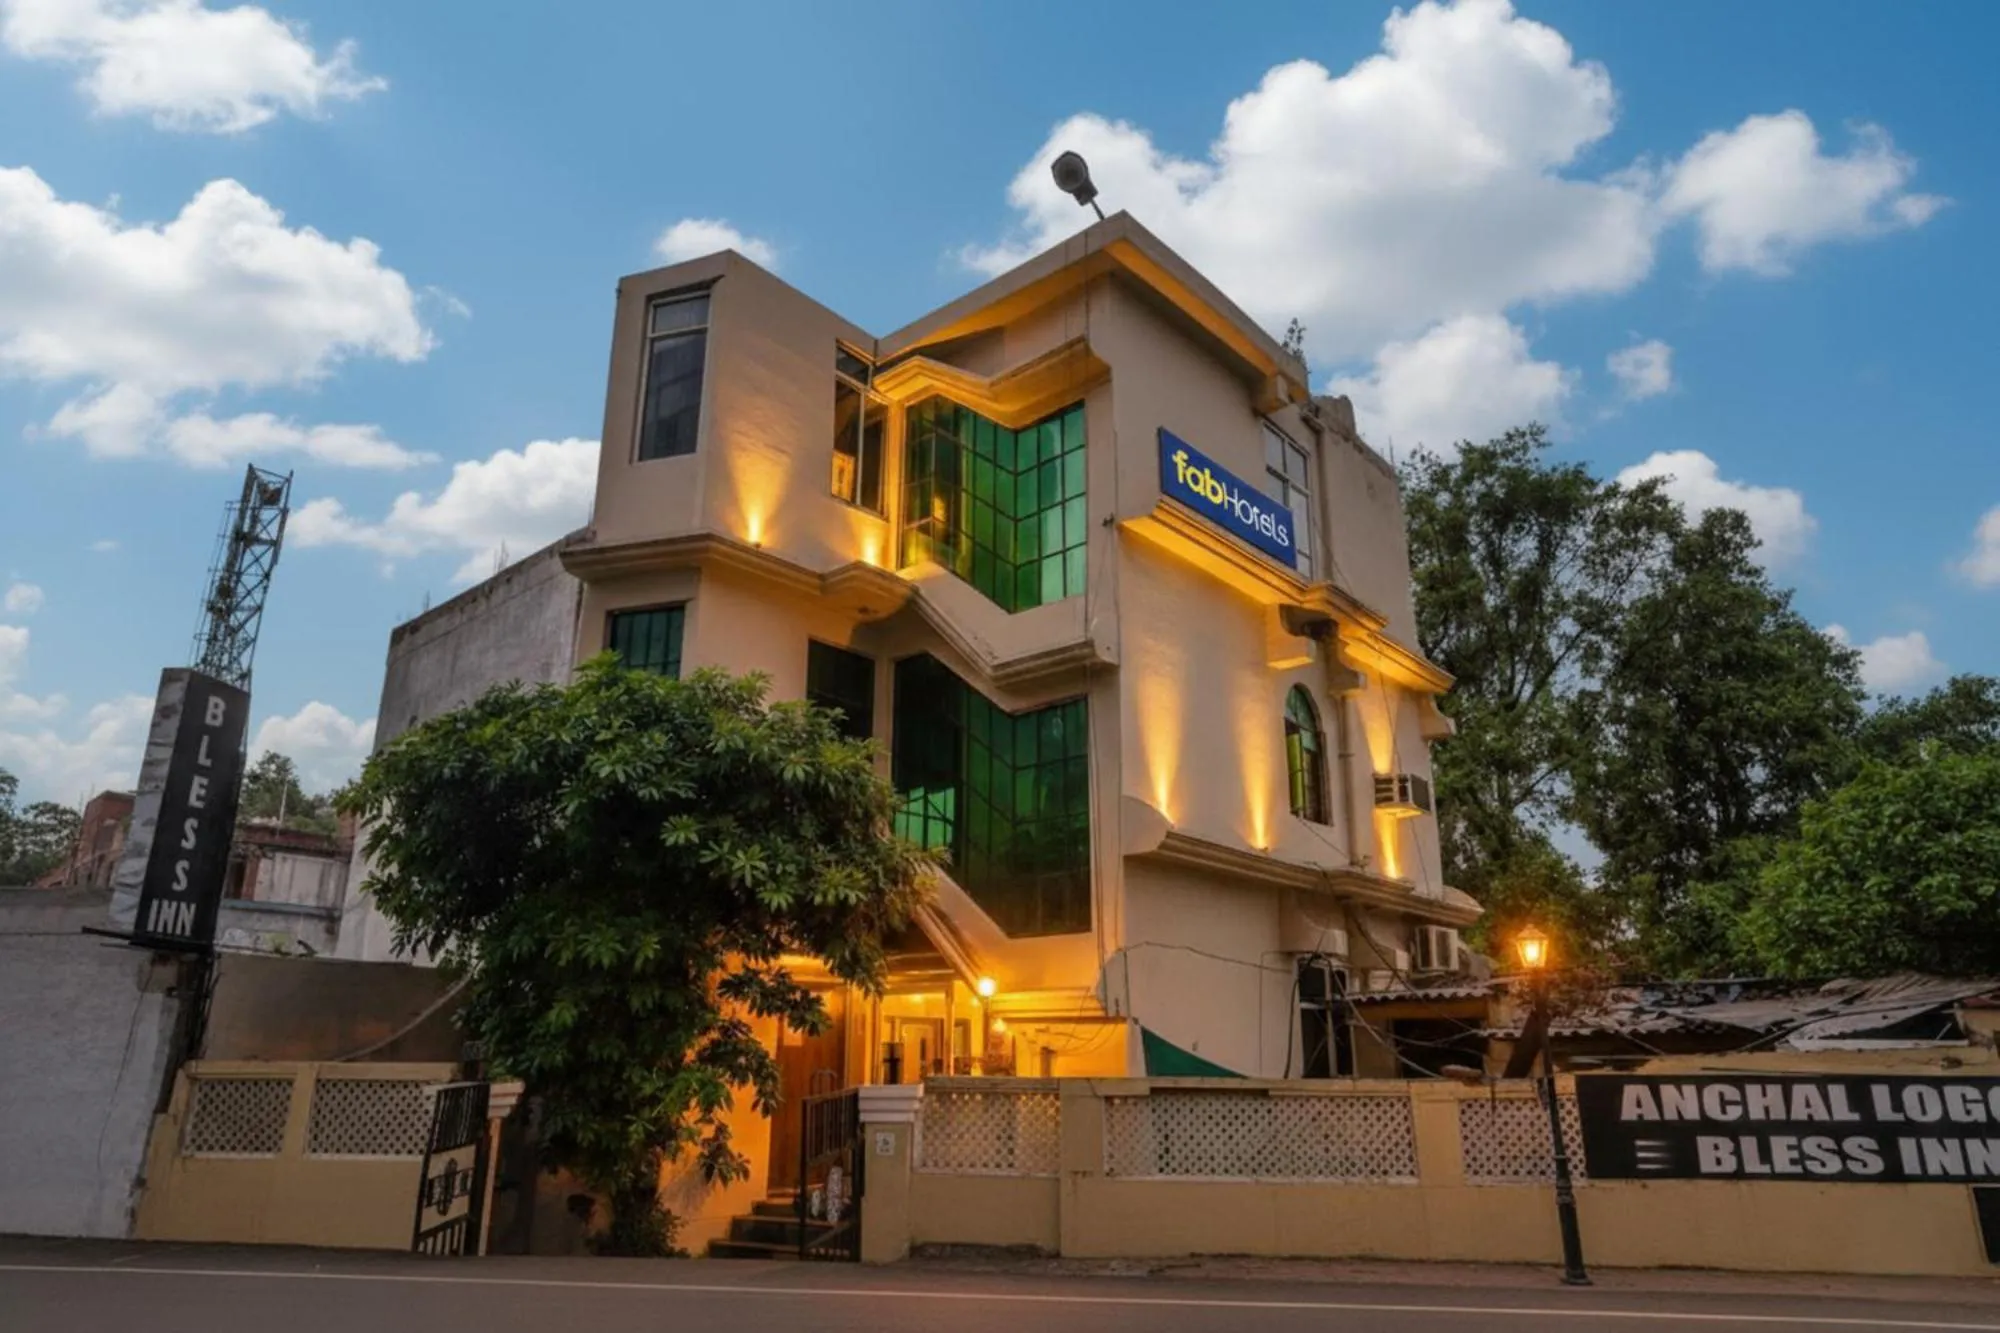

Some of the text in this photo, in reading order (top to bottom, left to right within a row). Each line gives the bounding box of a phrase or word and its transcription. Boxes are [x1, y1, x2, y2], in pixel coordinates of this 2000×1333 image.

[1172, 449, 1289, 547] fabHotels
[172, 695, 227, 893] BLESS
[146, 898, 197, 937] INN
[1619, 1083, 1861, 1122] ANCHAL
[1696, 1135, 2000, 1177] BLESS INN
